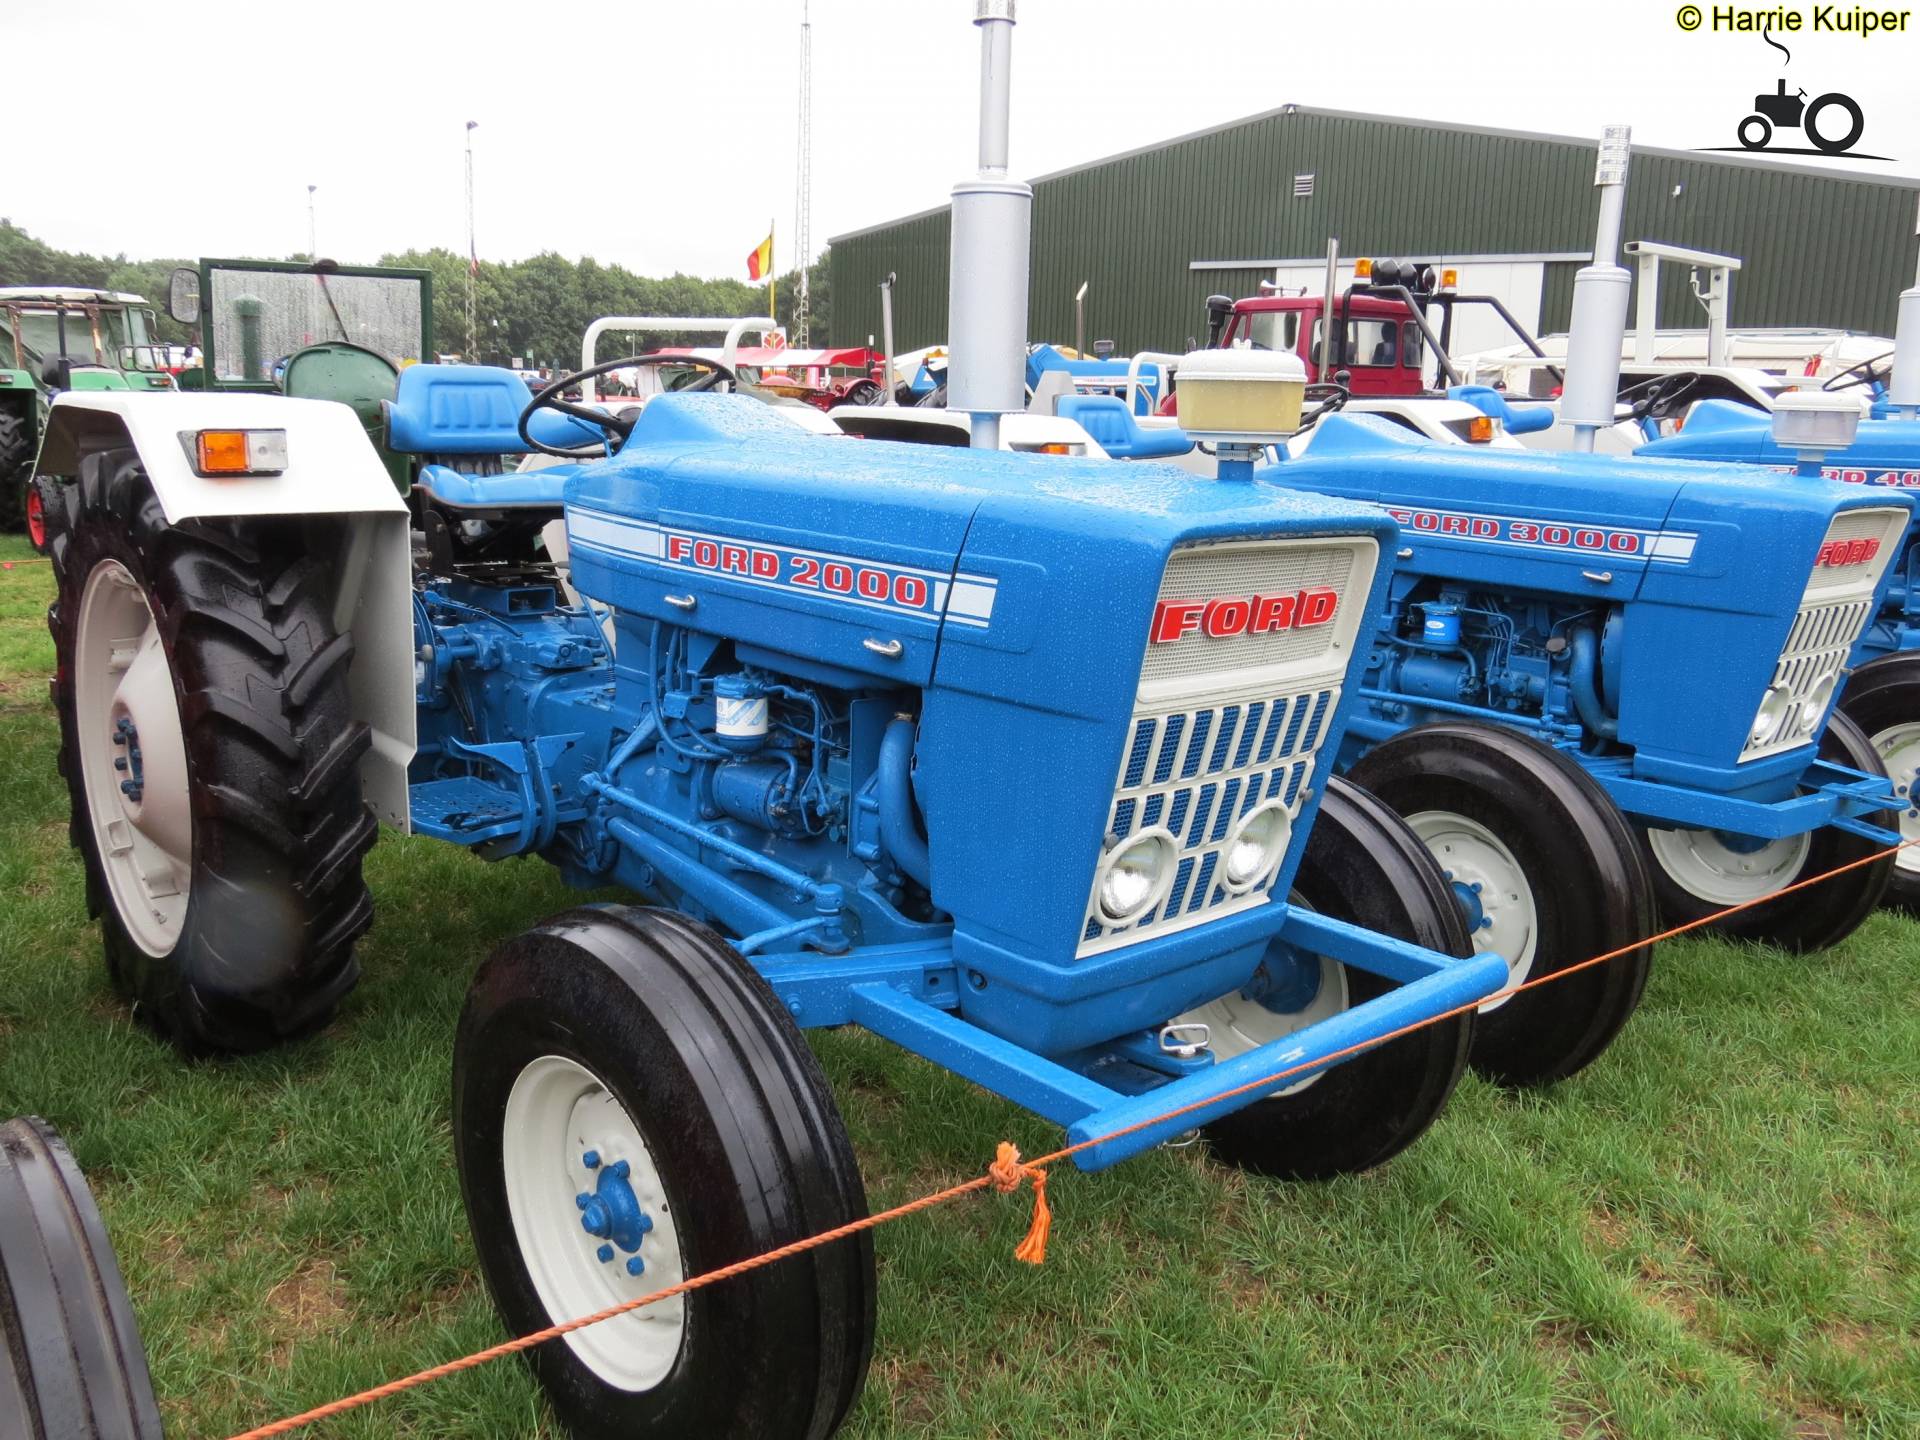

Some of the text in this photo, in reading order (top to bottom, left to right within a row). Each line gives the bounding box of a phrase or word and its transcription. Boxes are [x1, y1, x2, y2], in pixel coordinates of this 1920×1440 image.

[1509, 522, 1640, 554] 3000
[1814, 537, 1881, 568] FORD
[668, 535, 928, 609] FORD 2000
[1150, 586, 1338, 644] FORD
